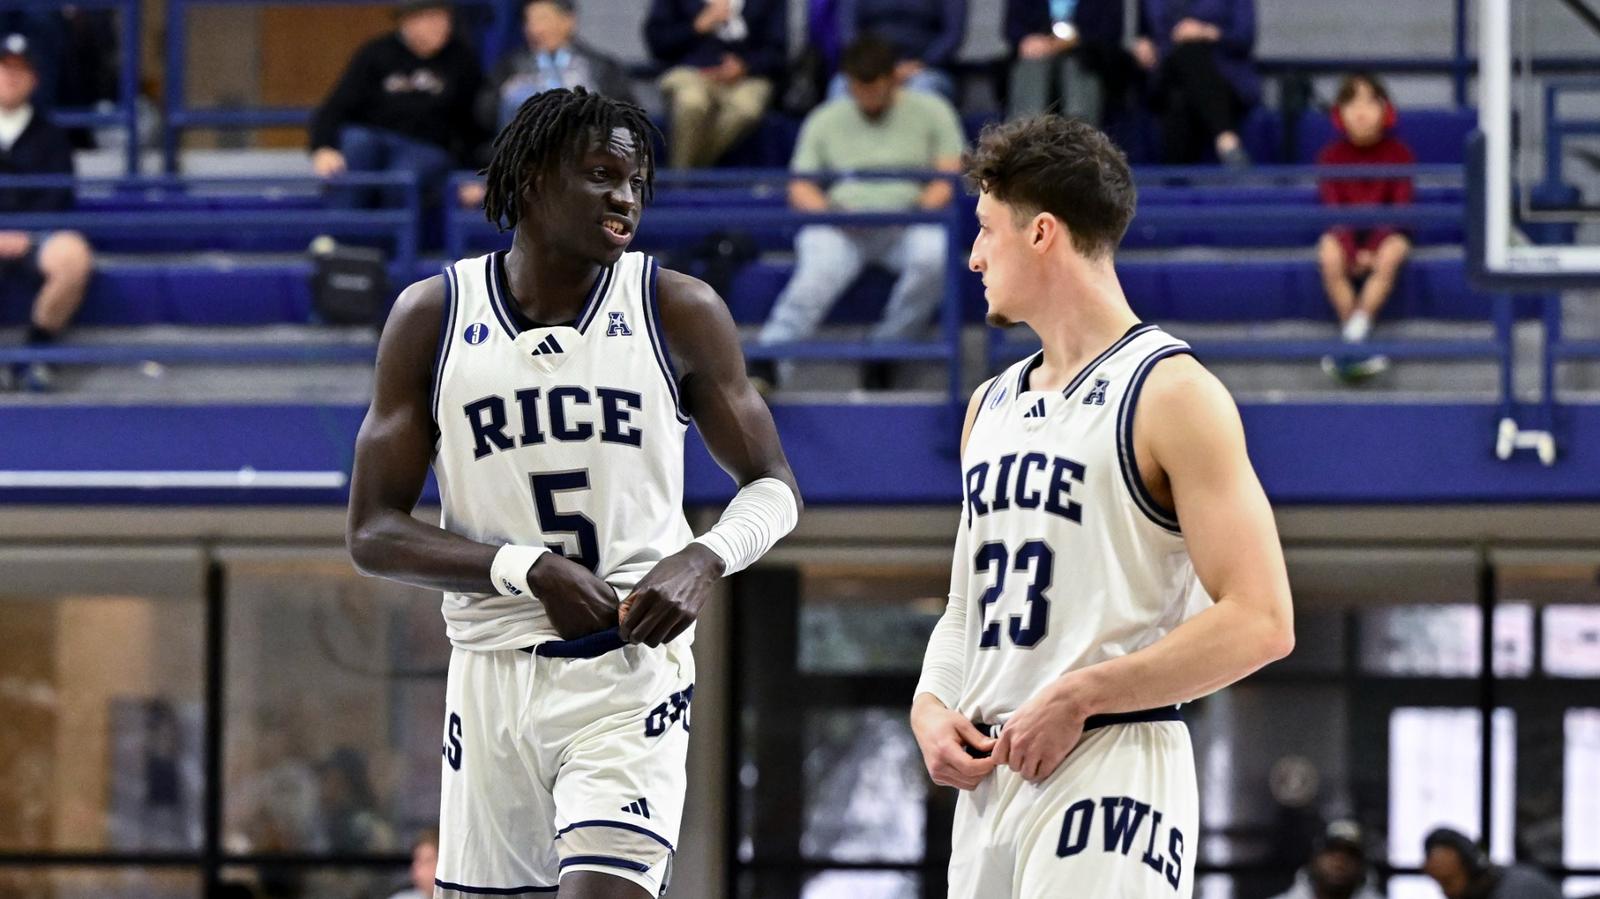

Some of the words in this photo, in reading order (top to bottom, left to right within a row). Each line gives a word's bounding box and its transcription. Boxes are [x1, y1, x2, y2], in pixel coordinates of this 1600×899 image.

[463, 385, 642, 461] RICE
[528, 467, 600, 574] 5
[966, 452, 1087, 531] RICE
[974, 538, 1055, 650] 23
[443, 712, 462, 772] S
[1056, 796, 1184, 891] OWLS
